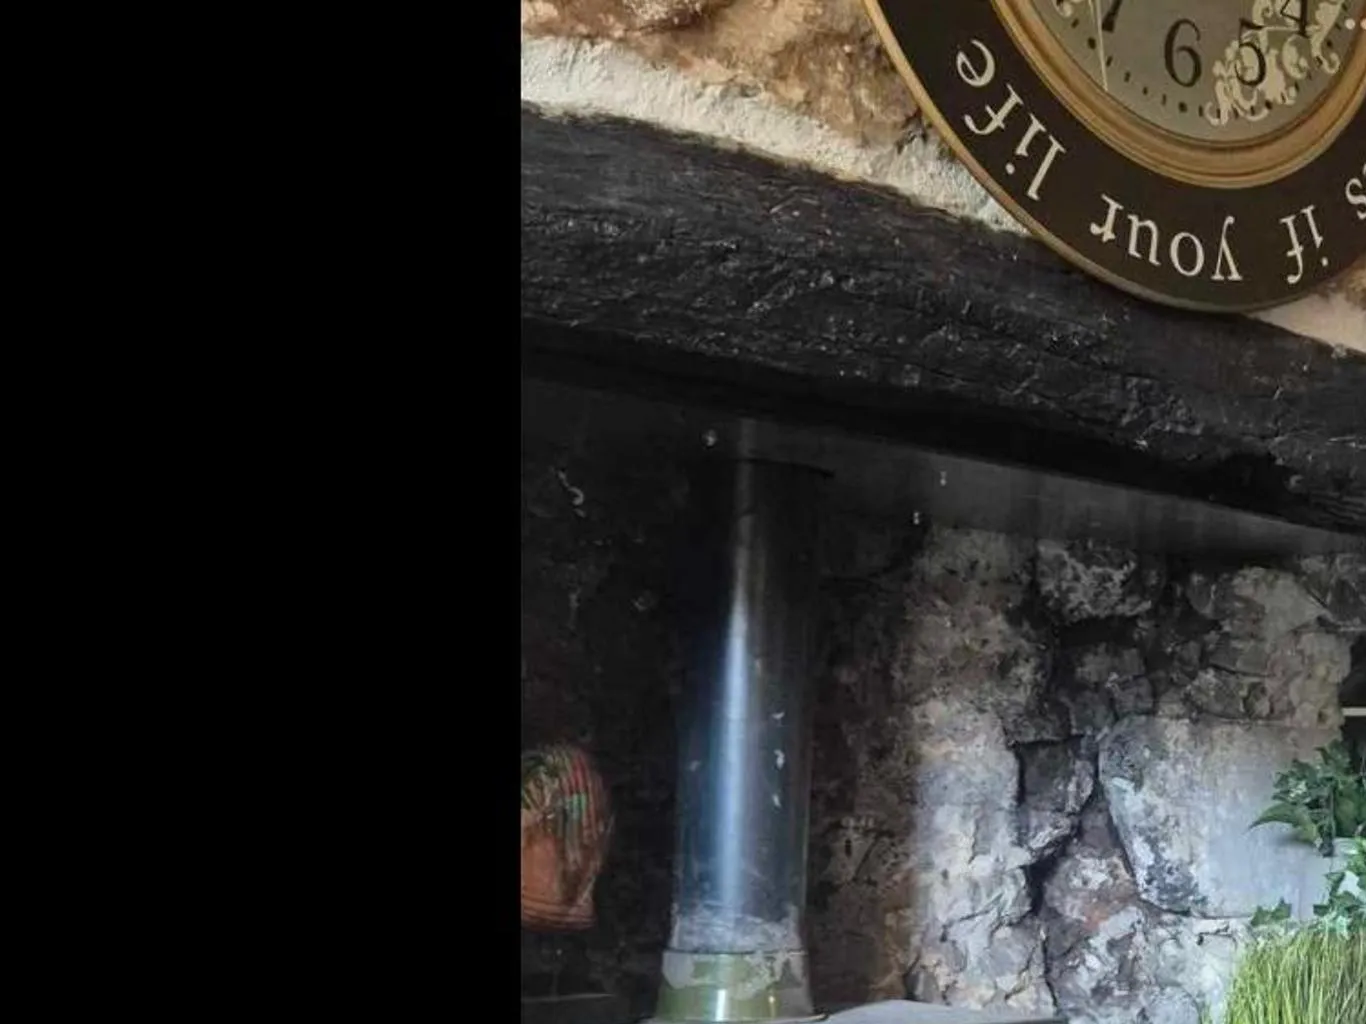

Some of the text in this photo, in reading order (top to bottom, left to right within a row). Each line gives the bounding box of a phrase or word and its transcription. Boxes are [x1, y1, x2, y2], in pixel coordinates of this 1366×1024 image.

[1164, 18, 1202, 87] 6
[1234, 17, 1266, 86] 5
[956, 39, 1066, 201] life
[1090, 193, 1243, 281] your
[1279, 204, 1329, 284] if
